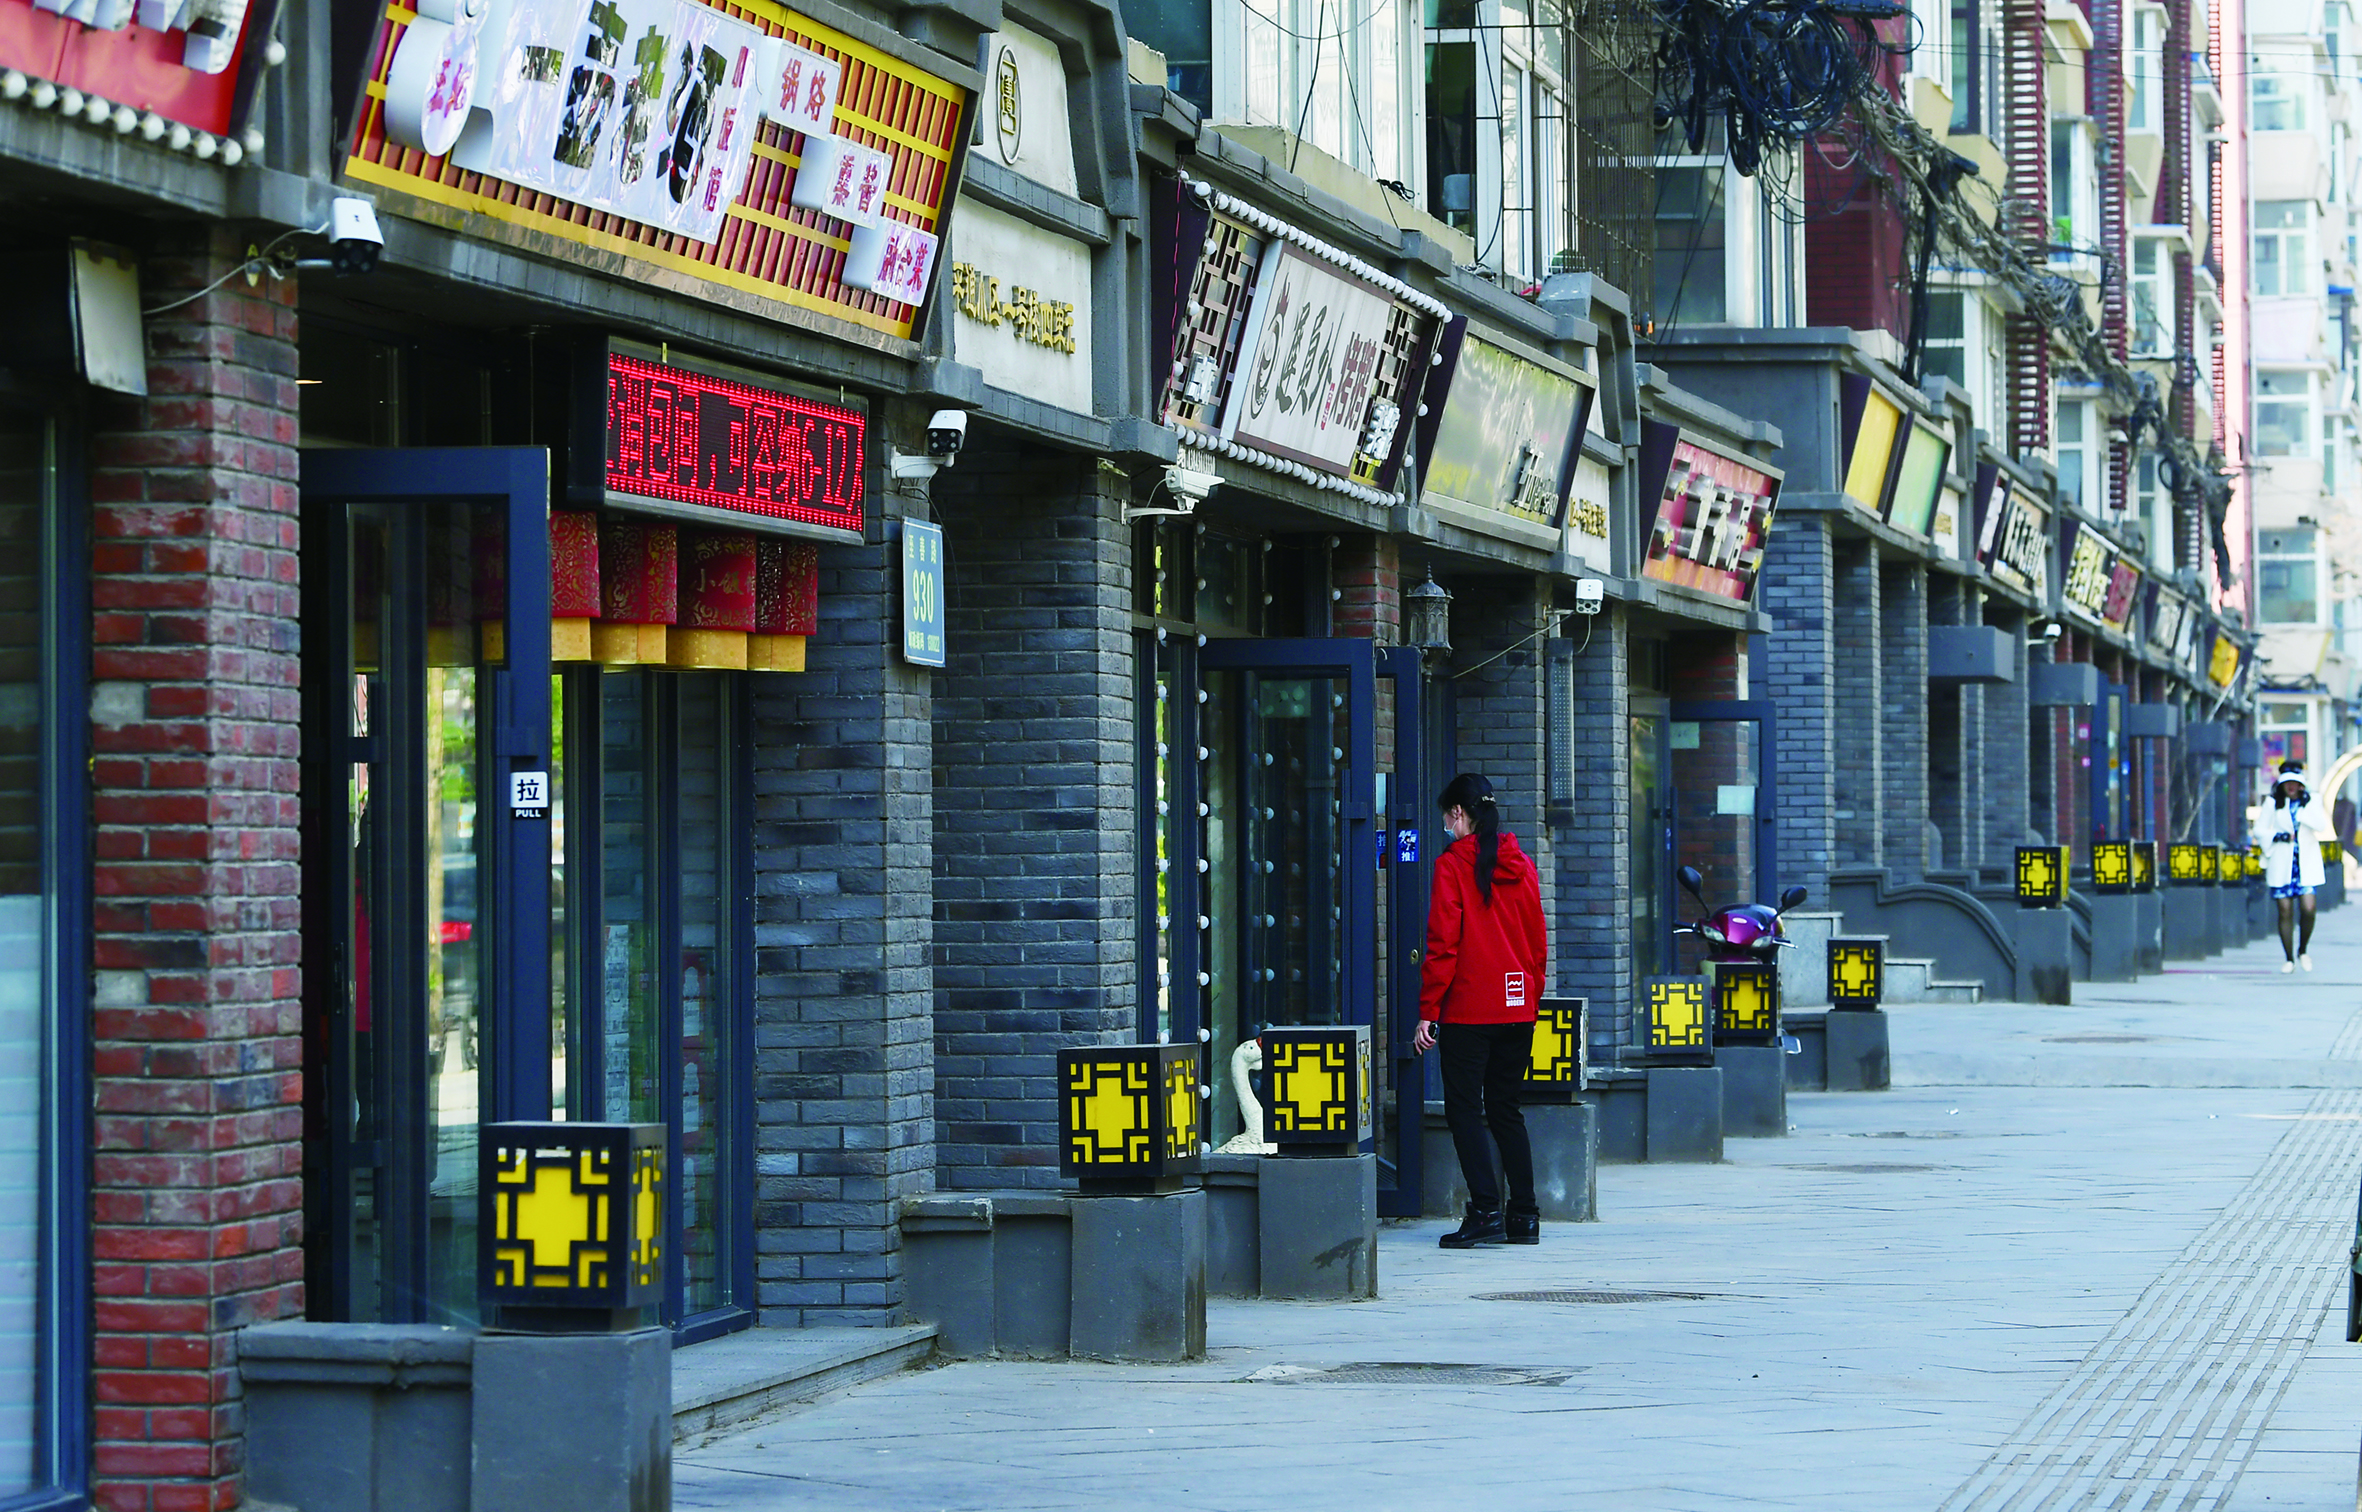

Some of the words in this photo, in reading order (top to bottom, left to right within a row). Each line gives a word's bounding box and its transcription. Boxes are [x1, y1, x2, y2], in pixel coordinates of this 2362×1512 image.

[779, 57, 827, 123] 锅烙
[912, 568, 935, 624] 930
[516, 778, 540, 802] 拉
[515, 808, 542, 818] PULL
